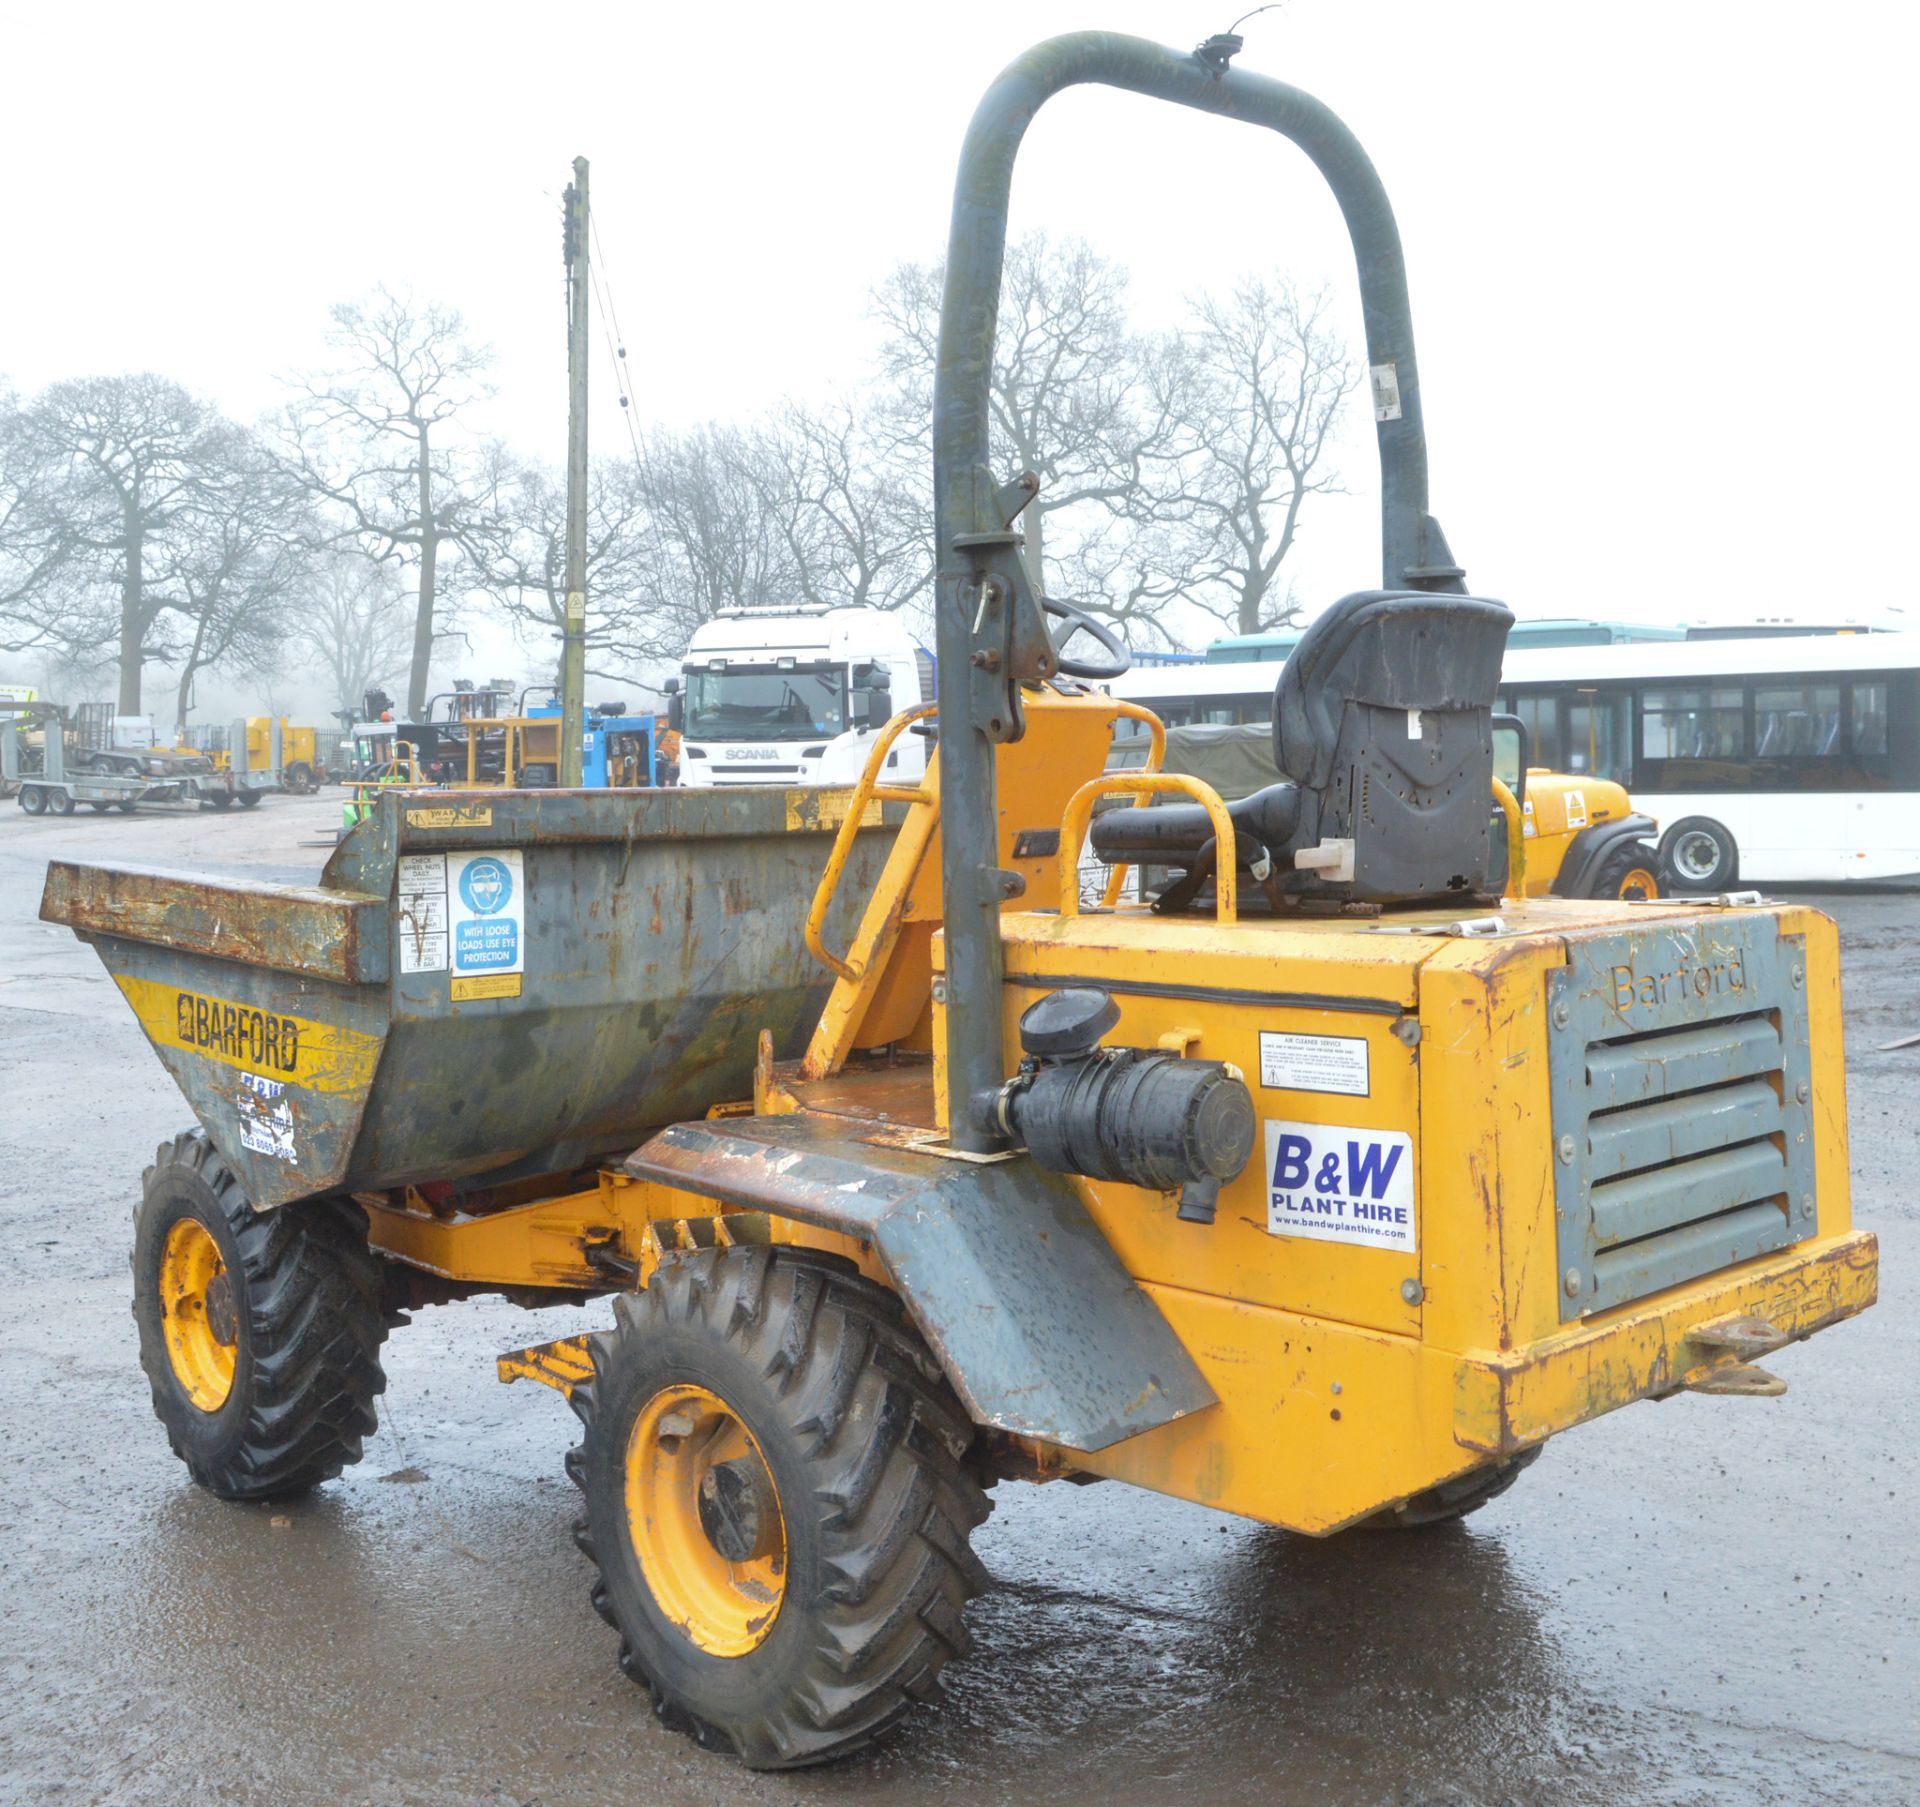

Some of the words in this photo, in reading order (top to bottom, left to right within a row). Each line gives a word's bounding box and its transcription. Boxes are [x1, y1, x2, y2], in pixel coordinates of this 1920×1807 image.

[725, 749, 779, 760] SCANIA
[425, 863, 441, 871] NUTS
[463, 927, 483, 937] WITH
[485, 924, 511, 936] LOOSE
[458, 940, 483, 951] LOADS
[486, 938, 500, 949] USE
[502, 937, 516, 948] EYE
[463, 951, 510, 964] PROTECTION
[1610, 948, 1747, 1012] Barford
[196, 997, 298, 1073] BARFORD
[1295, 1038, 1318, 1046] CLEANER
[1272, 1133, 1404, 1200] B&W
[1272, 1193, 1347, 1216] PLANT
[1354, 1202, 1408, 1225] HIRE
[1275, 1216, 1406, 1239] www.bandwplanthire.com
